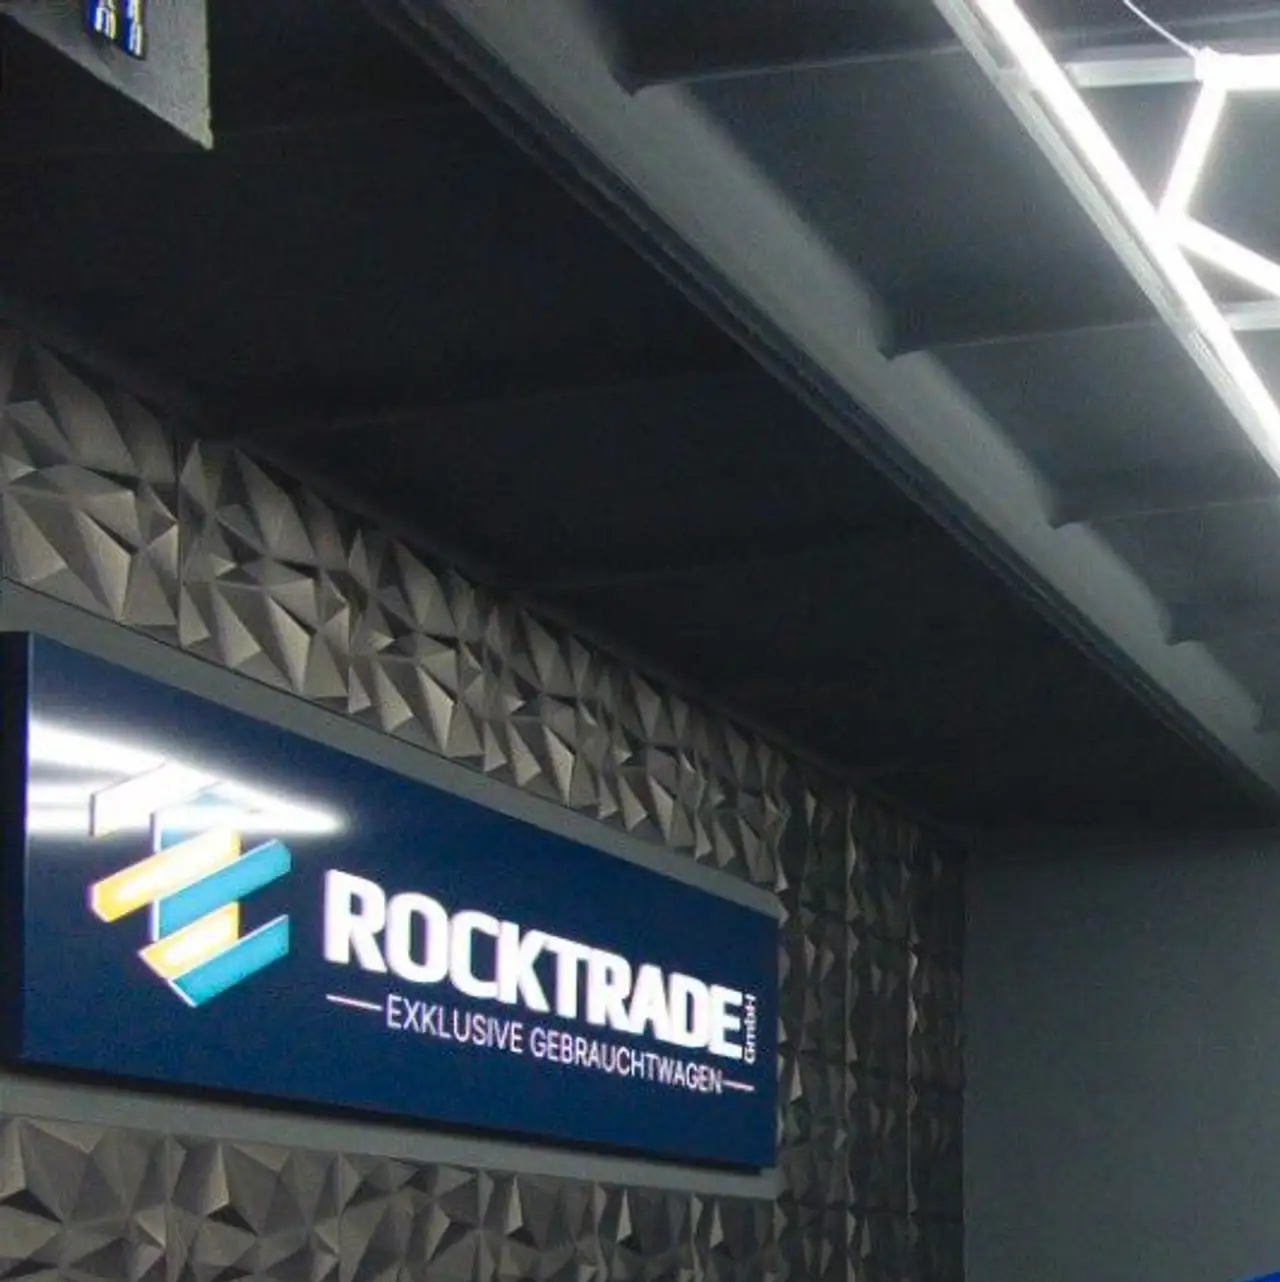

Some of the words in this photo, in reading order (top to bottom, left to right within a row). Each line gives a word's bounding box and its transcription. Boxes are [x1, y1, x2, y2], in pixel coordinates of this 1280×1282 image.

[323, 869, 743, 1059] ROCKTRADE
[386, 993, 524, 1051] EXKLUSIVE
[529, 1027, 722, 1094] GEBRAUCHTWAGEN
